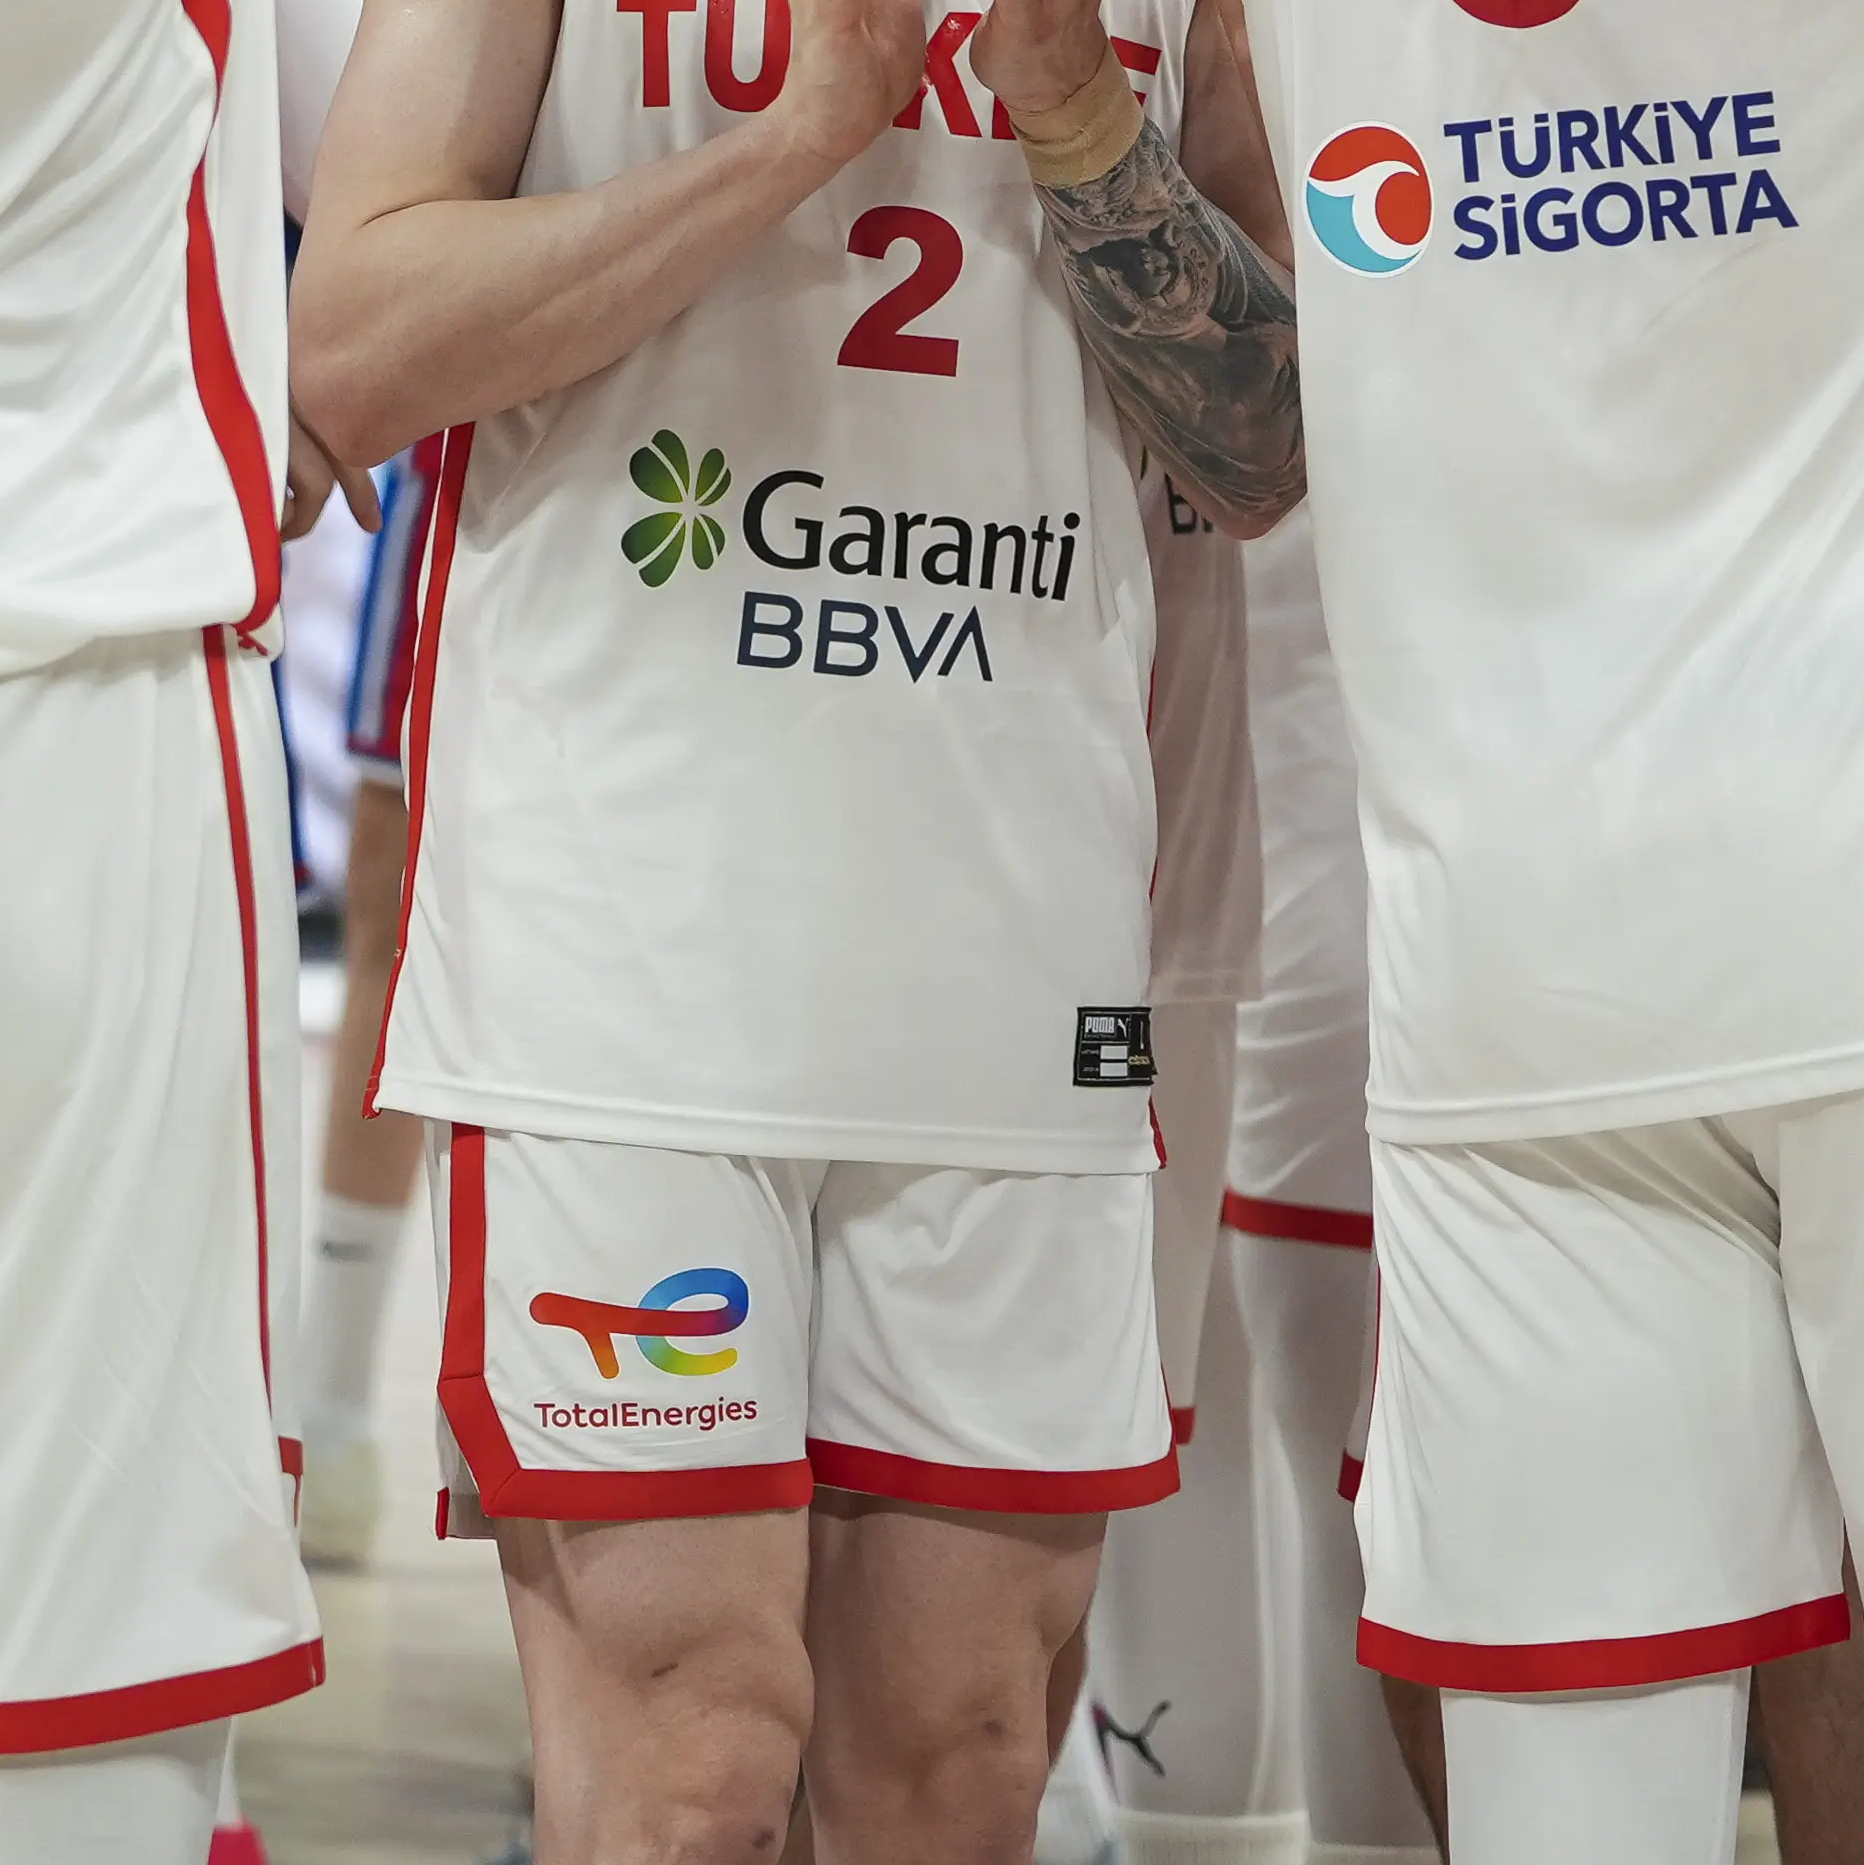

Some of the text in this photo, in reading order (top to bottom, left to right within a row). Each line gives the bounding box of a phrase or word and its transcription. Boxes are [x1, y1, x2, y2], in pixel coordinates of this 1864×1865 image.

[836, 205, 965, 378] 2
[741, 469, 1081, 601] Garanti
[735, 590, 994, 684] BBVA
[1084, 1016, 1115, 1034] PUMA
[533, 1398, 760, 1433] TotalEnergies
